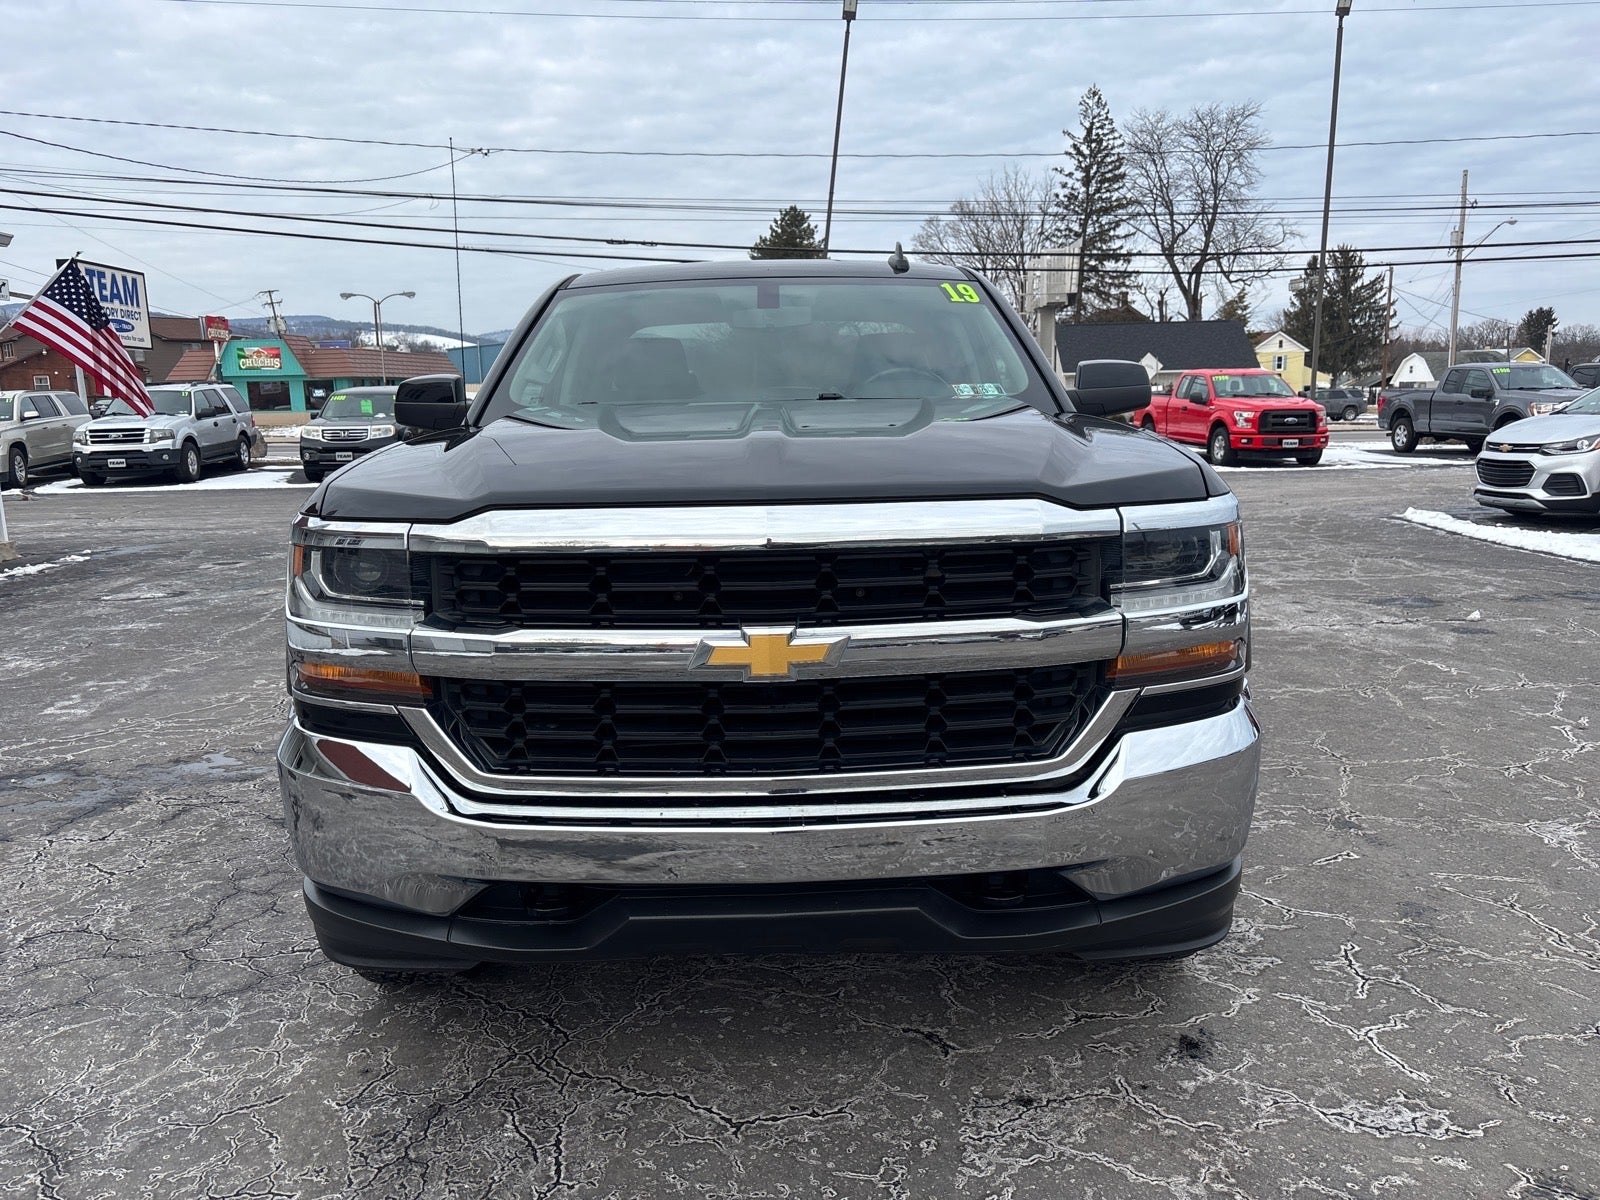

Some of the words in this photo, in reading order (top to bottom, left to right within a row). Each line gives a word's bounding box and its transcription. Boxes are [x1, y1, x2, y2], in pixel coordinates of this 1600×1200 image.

[84, 267, 140, 309] TEAM
[940, 282, 980, 303] 19
[120, 308, 142, 321] DIRECT
